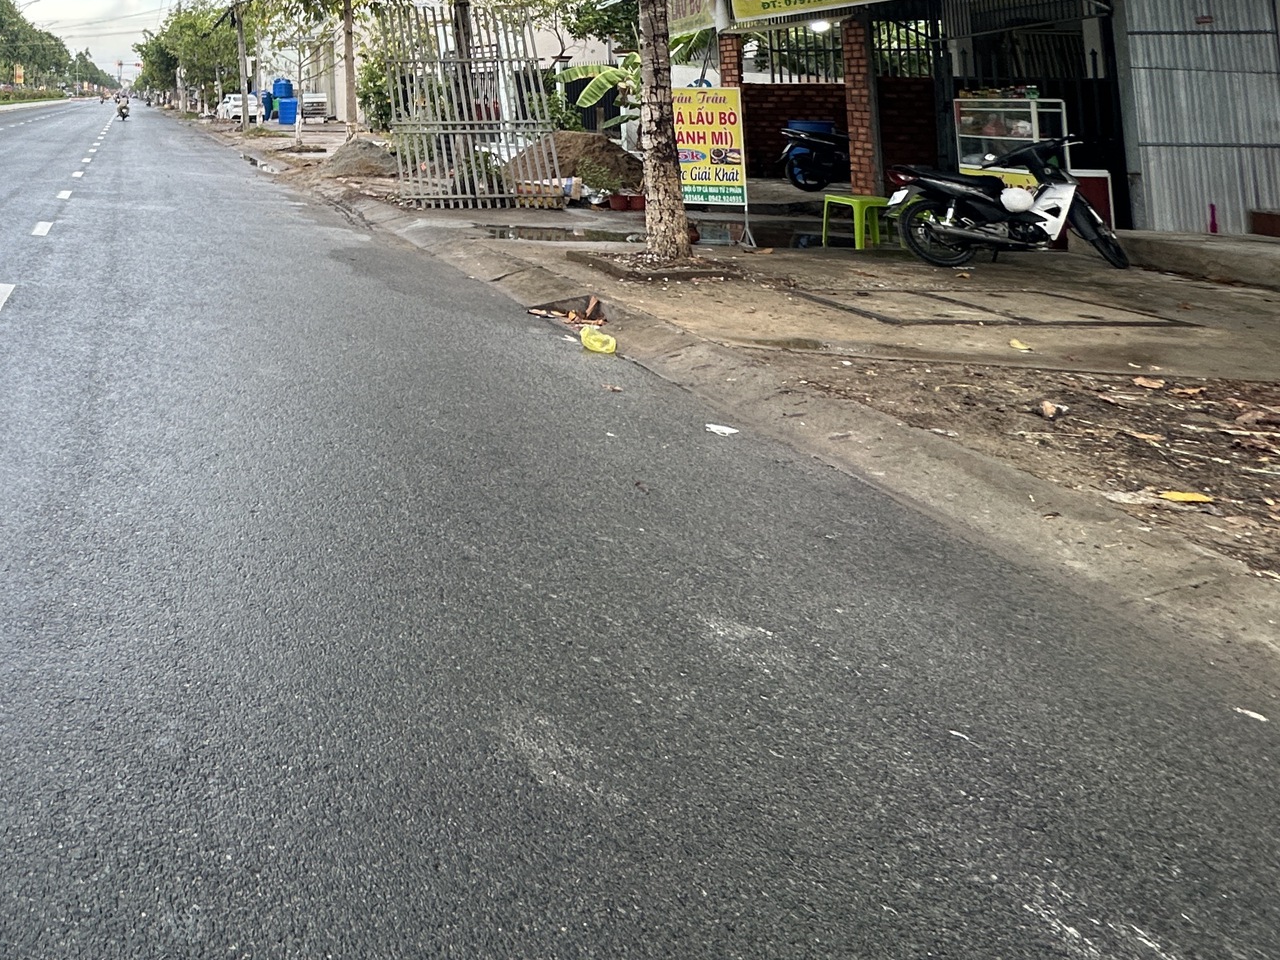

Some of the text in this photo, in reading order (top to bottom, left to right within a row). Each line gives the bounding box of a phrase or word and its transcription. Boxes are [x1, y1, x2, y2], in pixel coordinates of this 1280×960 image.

[761, 1, 782, 11] ĐT:
[672, 93, 693, 104] rân
[676, 106, 738, 126] Á LẤU BÒ
[677, 127, 707, 145] ÁNH
[678, 151, 702, 161] 5k
[690, 166, 711, 182] Giải
[714, 167, 740, 182] Khát
